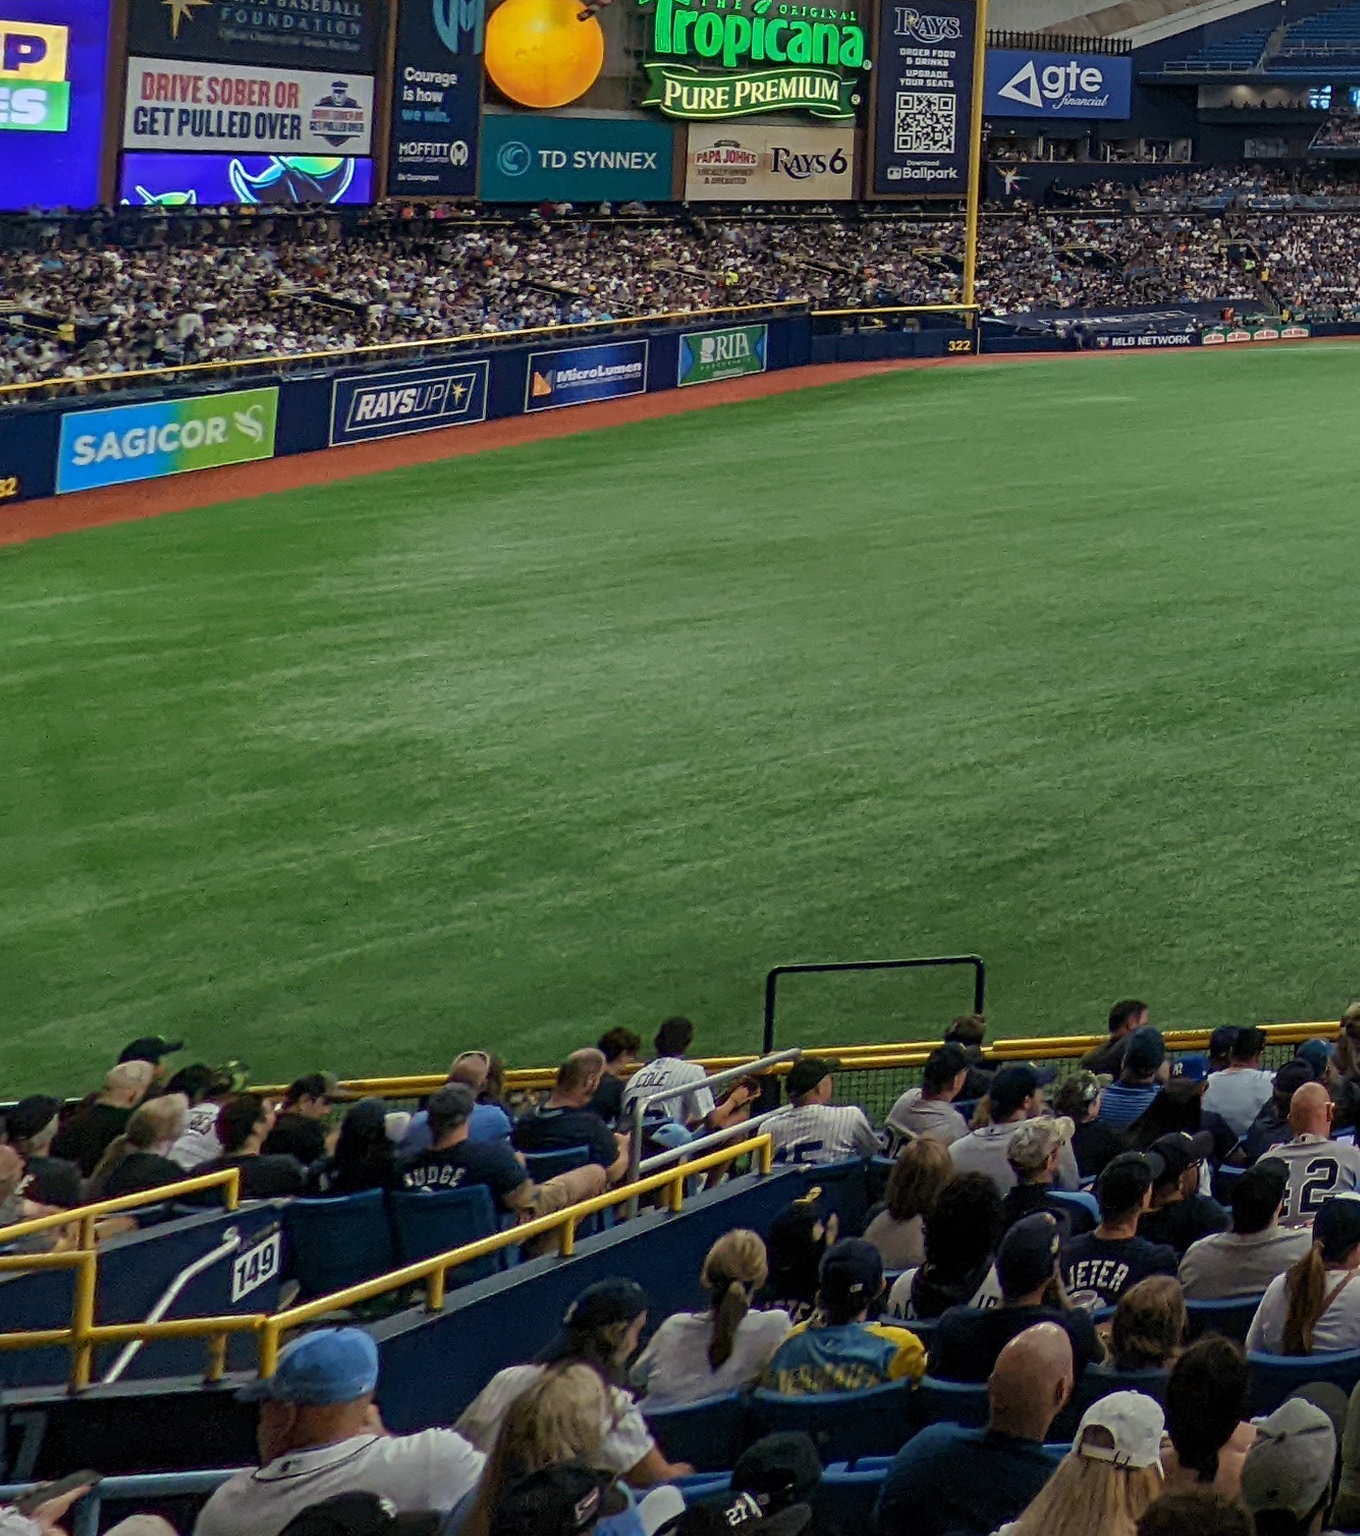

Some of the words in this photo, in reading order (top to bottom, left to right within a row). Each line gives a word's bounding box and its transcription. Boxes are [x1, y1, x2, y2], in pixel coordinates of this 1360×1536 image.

[220, 7, 362, 35] FOUNDATION
[779, 4, 857, 22] ORIGINAL
[899, 47, 931, 59] ORDER
[932, 49, 957, 60] FOOD
[915, 57, 950, 68] DRINKS
[404, 66, 458, 88] Courage
[899, 78, 925, 88] YOUR
[925, 79, 955, 88] SEATS
[905, 68, 949, 79] UPGRADE
[1041, 61, 1104, 100] gte
[141, 71, 202, 104] DRIVE
[207, 76, 271, 107] SOBER
[274, 80, 300, 109] OR
[403, 85, 414, 101] is
[416, 87, 444, 102] how
[664, 79, 730, 110] PURE
[733, 76, 840, 109] PREMIUM
[1051, 93, 1109, 110] financial
[133, 106, 174, 136] GET
[178, 108, 251, 139] PULLED
[254, 113, 302, 141] OVER
[399, 142, 450, 156] MOFFITT
[696, 150, 721, 164] PAPA
[538, 150, 567, 168] TD
[573, 150, 657, 170] SYNNEX
[829, 148, 848, 174] 6
[902, 166, 958, 181] Ballpark
[948, 339, 971, 352] 322
[1112, 336, 1135, 347] MLB
[1137, 333, 1190, 346] NETWORK
[556, 362, 642, 383] MicroLumen
[72, 416, 228, 466] SAGICOR
[634, 1070, 673, 1088] COLE
[236, 1242, 276, 1293] 149
[1066, 1258, 1131, 1292] JETER
[725, 1499, 749, 1527] 27
